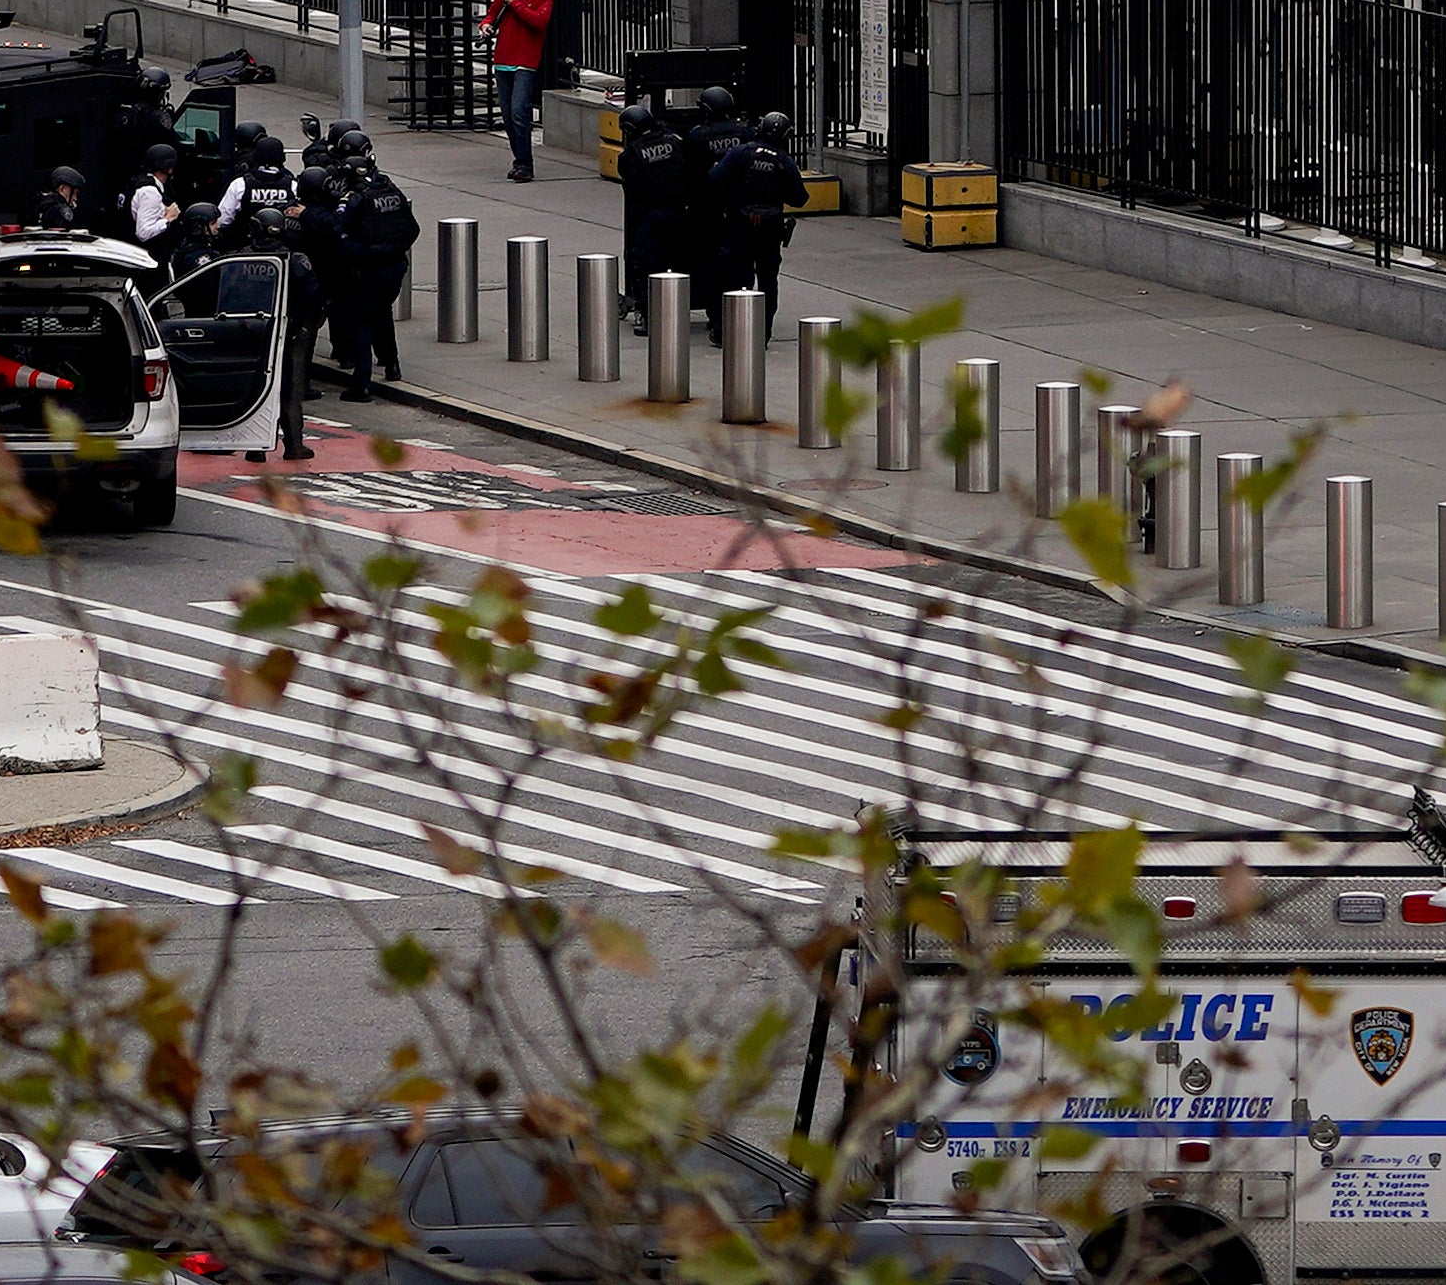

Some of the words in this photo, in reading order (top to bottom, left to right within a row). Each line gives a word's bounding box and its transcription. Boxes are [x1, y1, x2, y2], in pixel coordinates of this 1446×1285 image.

[709, 137, 741, 150] NYPD
[641, 143, 673, 160] NYPD
[250, 188, 288, 201] NYPD
[373, 195, 402, 208] NYPD
[1365, 1010, 1400, 1020] POLICE
[1187, 1097, 1274, 1119] SERVICE
[946, 1140, 979, 1158] 5740
[1021, 1140, 1030, 1158] 2
[1360, 1154, 1402, 1168] Memory
[1406, 1153, 1423, 1166] Of
[1335, 1172, 1360, 1181] Sgt.
[1365, 1172, 1380, 1180] M.
[1385, 1172, 1426, 1180] Curtin
[1331, 1181, 1357, 1189] Det.
[1378, 1181, 1430, 1190] Vigiano
[1335, 1190, 1361, 1198] P.O.
[1369, 1199, 1428, 1208] McCormack
[1329, 1209, 1355, 1218] ESS
[1362, 1209, 1413, 1218] TRUCK
[1420, 1209, 1430, 1218] 2
